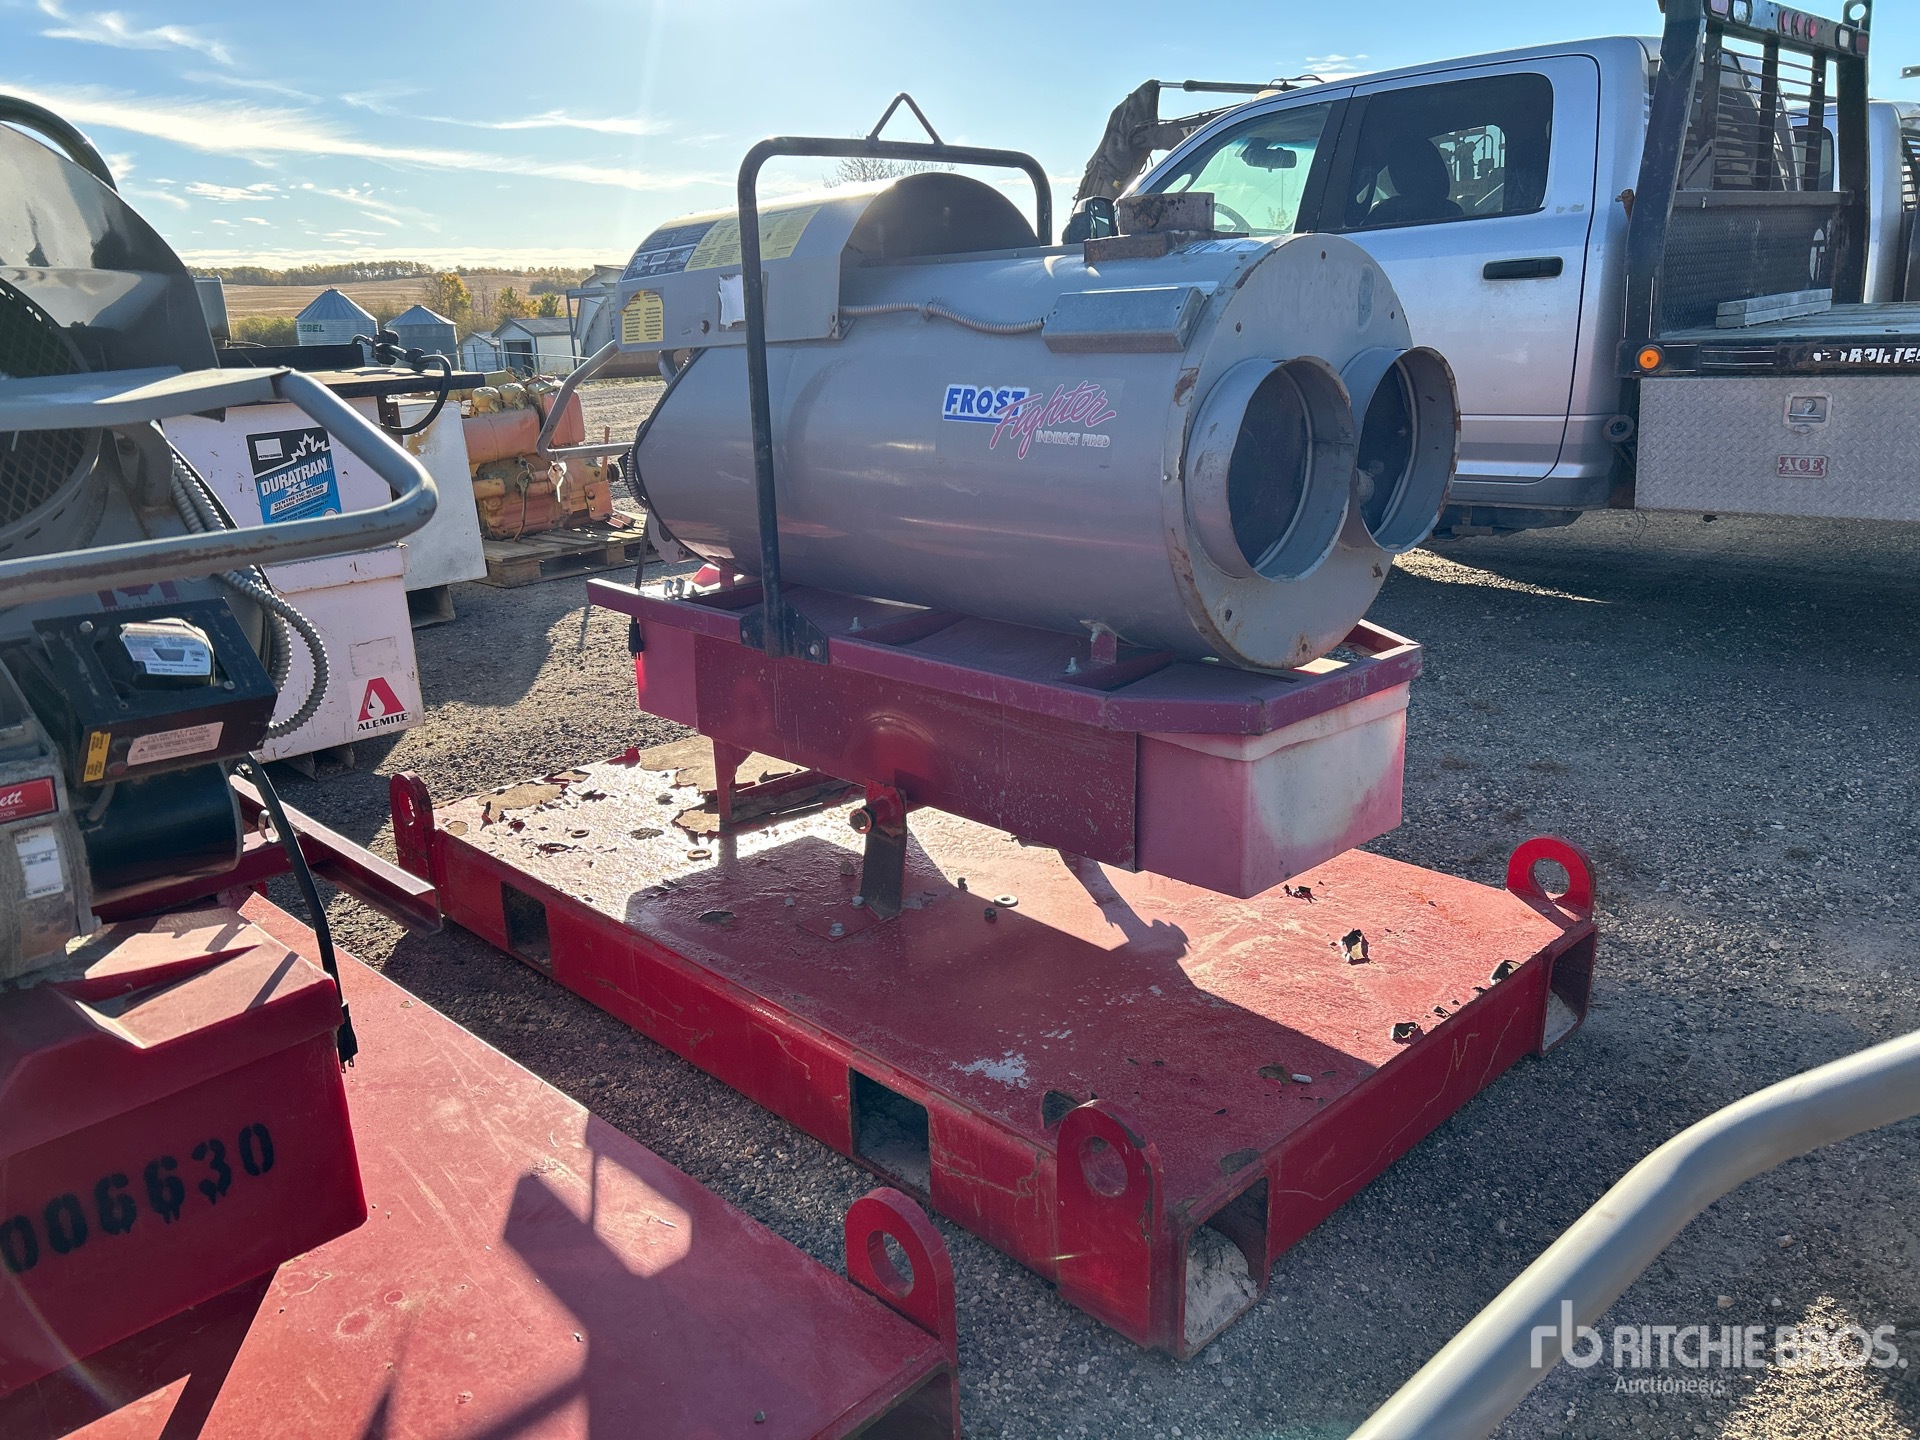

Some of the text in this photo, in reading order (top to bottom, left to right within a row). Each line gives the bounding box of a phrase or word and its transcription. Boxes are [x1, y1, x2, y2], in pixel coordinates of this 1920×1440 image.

[944, 386, 1028, 418] FROST
[989, 380, 1116, 459] Fighter
[1035, 429, 1110, 448] INDIRECT FIRED
[260, 457, 328, 496] DURATRAN
[1782, 457, 1821, 472] ACE
[285, 481, 312, 496] XL
[357, 712, 409, 732] ALEMITE
[0, 1122, 275, 1274] 006630
